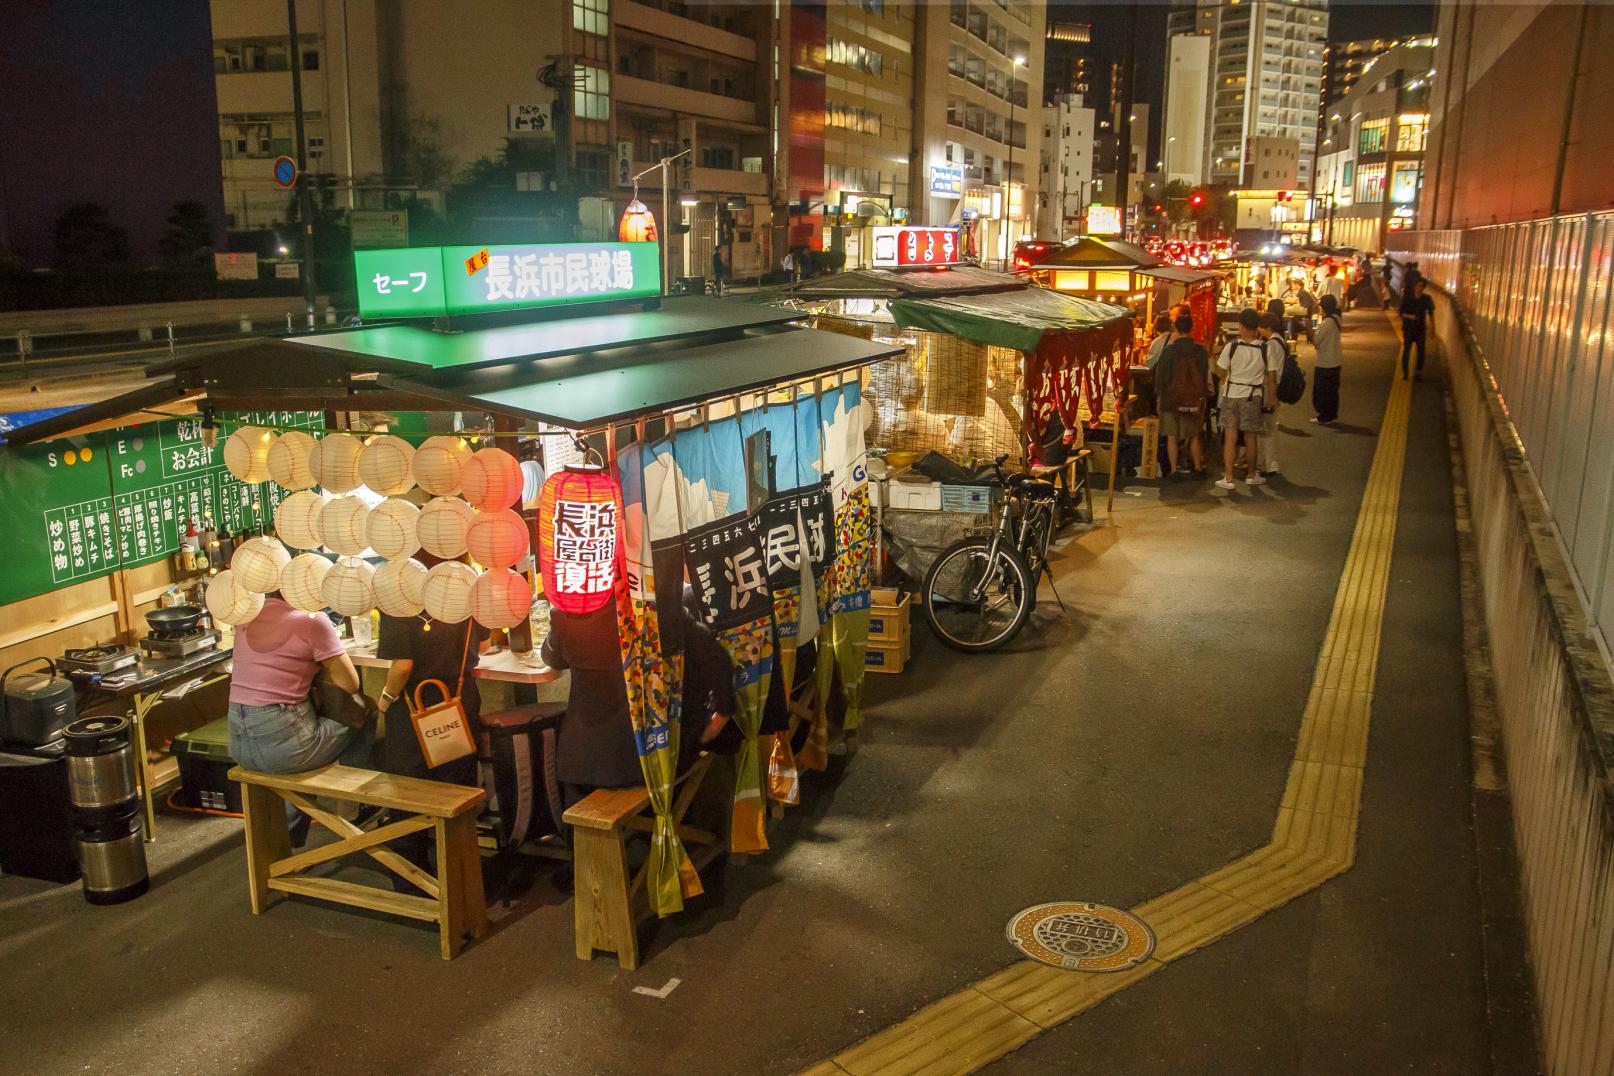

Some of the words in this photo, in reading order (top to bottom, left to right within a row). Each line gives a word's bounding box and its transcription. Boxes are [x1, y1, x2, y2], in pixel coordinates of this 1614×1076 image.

[467, 251, 489, 273] 屋台
[373, 272, 427, 295] セーフ
[485, 250, 634, 301] 長浜市民球場
[48, 453, 58, 467] S
[118, 440, 126, 455] E
[172, 447, 214, 471] お会計
[121, 464, 134, 478] Fc
[162, 498, 173, 521] 炒飯
[177, 495, 186, 537] キムチ炒
[554, 501, 616, 537] 長浜
[49, 519, 68, 571] 炒め物
[69, 519, 85, 567] 野菜炒め
[84, 516, 99, 563] 豚キムチ
[100, 512, 114, 560] 焼きそば
[556, 538, 615, 563] 屋台街
[555, 563, 616, 594] 復活
[425, 720, 461, 738] CELINE
